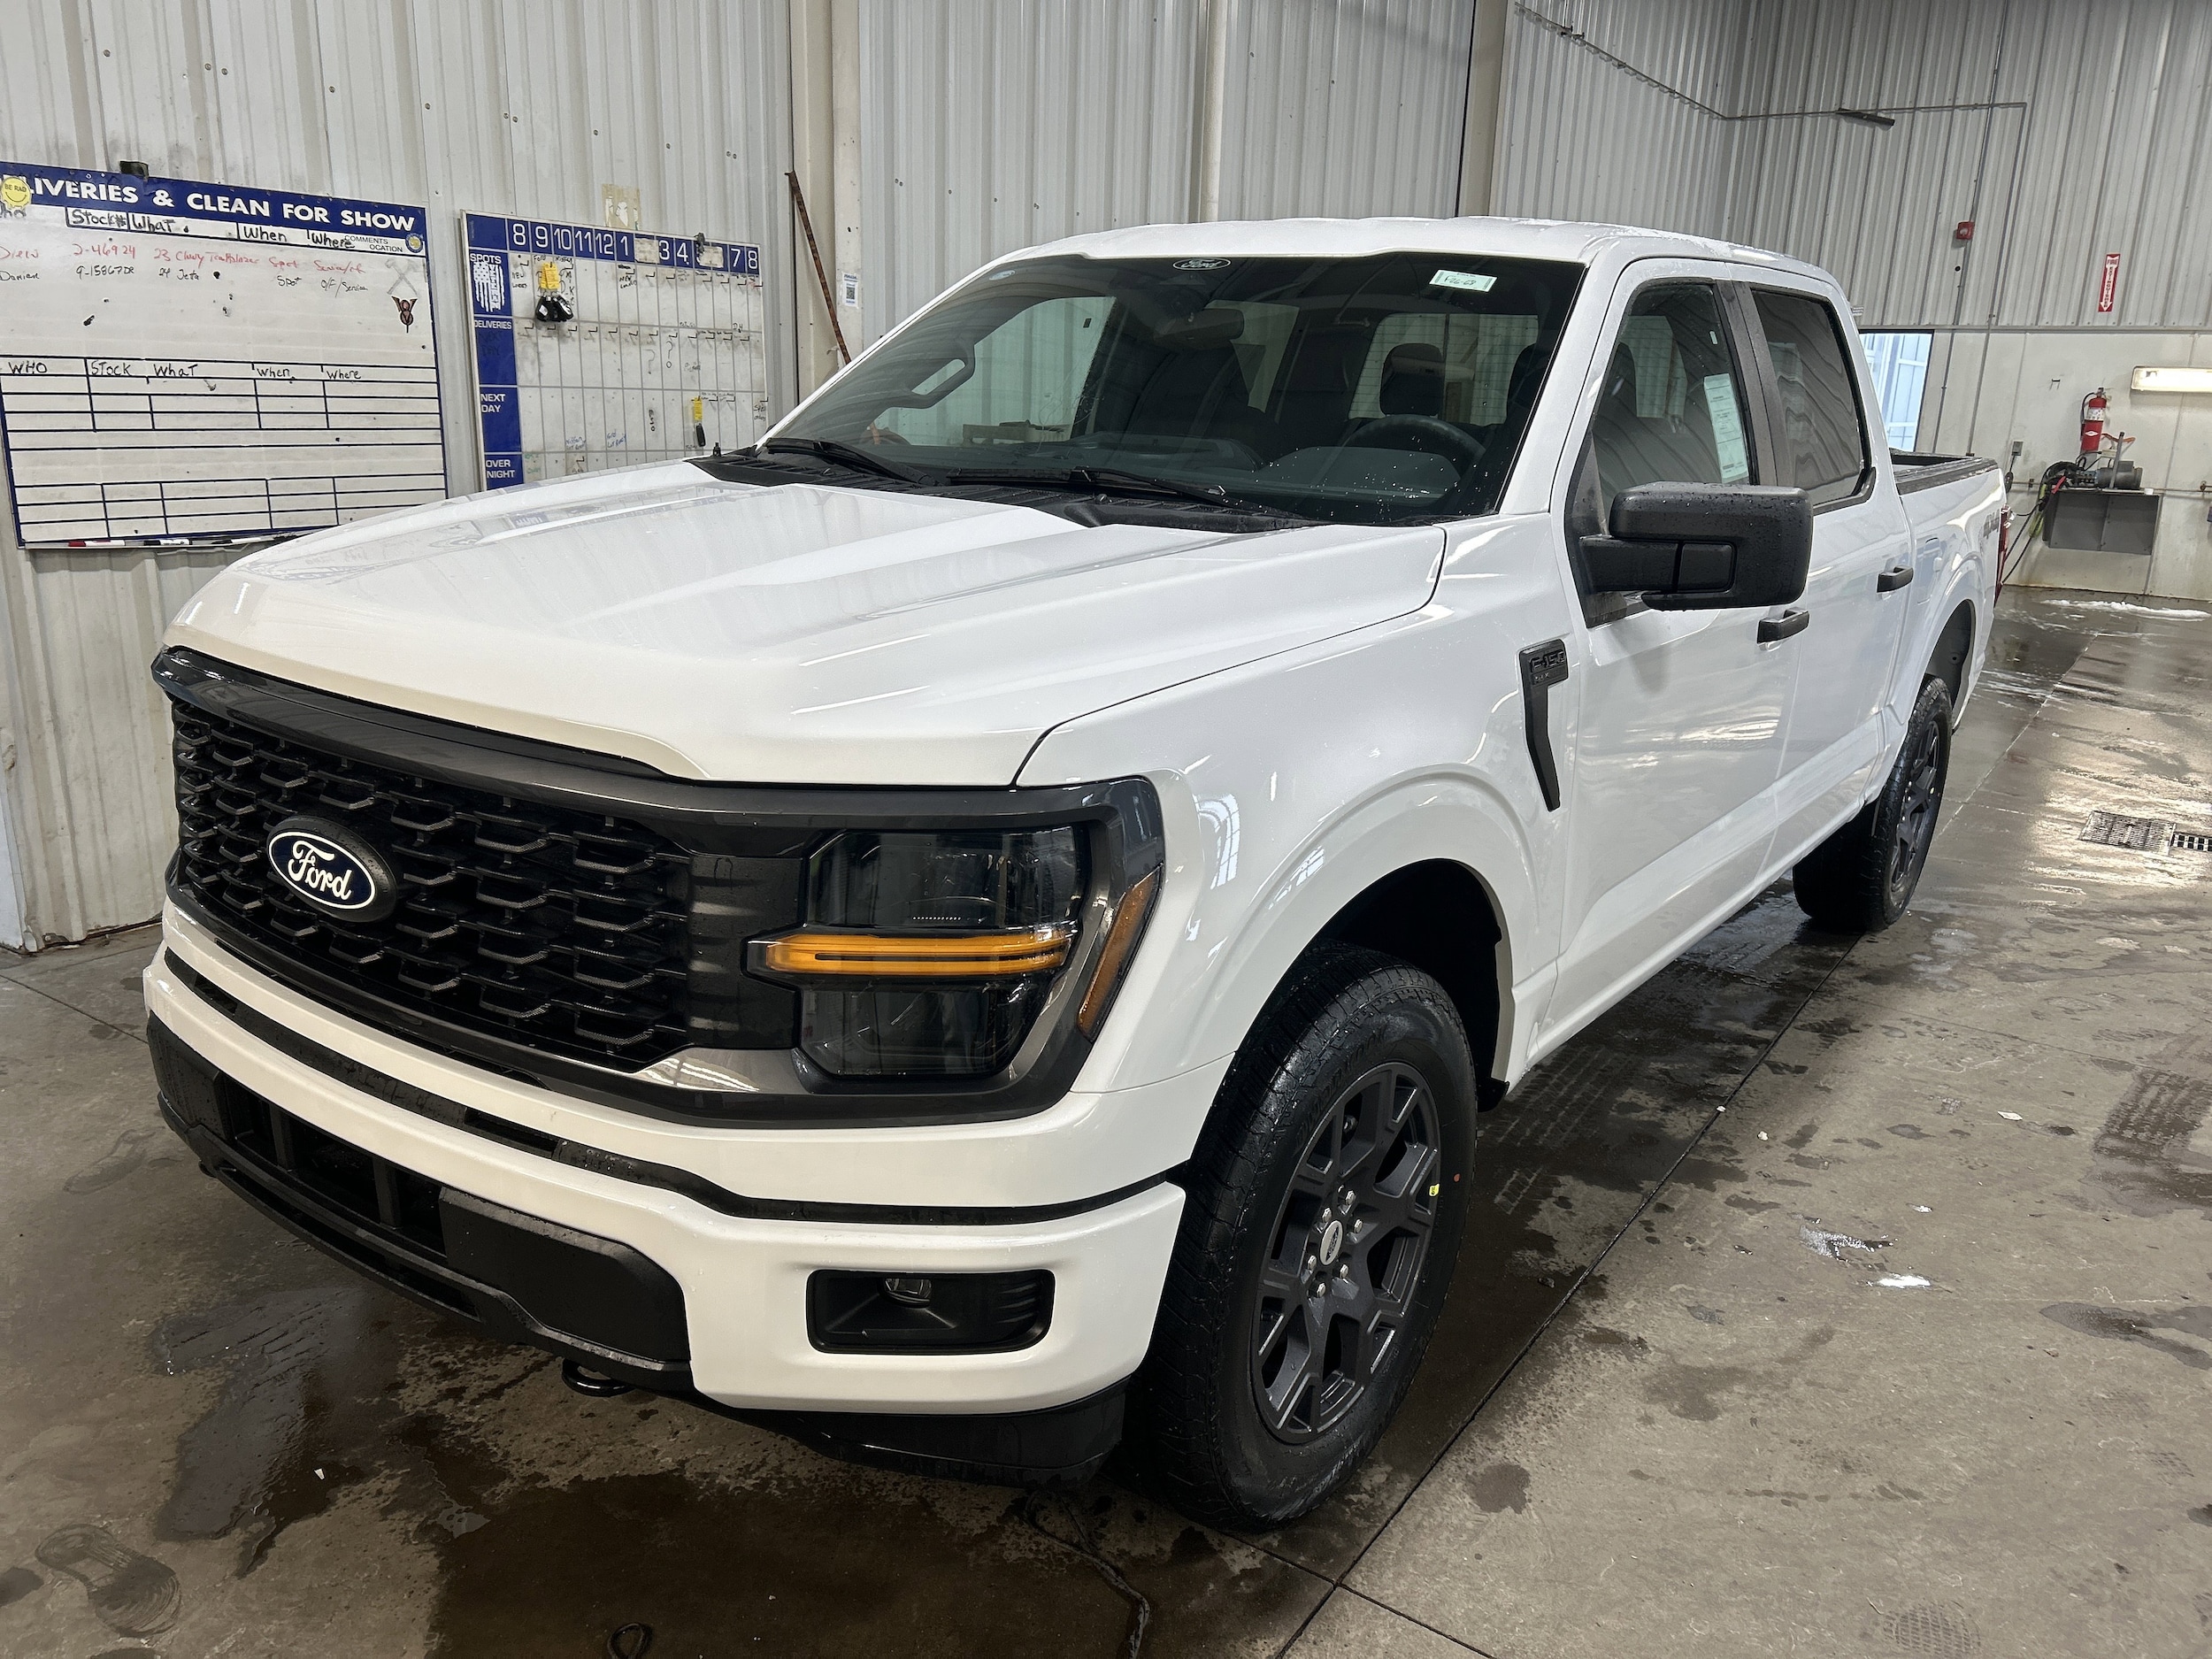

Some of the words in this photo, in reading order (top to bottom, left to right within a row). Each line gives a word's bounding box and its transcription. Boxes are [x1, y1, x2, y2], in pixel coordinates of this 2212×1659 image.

[14, 184, 27, 193] RAD
[0, 174, 139, 204] LIVERIES
[153, 190, 174, 207] &
[187, 193, 270, 217] CLEAN
[282, 203, 330, 224] FOR
[341, 210, 415, 231] SHOW
[243, 226, 288, 242] When
[311, 232, 355, 249] Where
[344, 234, 388, 245] COMMENTS
[512, 223, 526, 246] 8
[535, 226, 549, 248] 9
[554, 227, 572, 250] 10
[575, 230, 592, 252] 11
[595, 233, 614, 255] 12
[620, 235, 629, 257] 1
[658, 240, 670, 260] 3
[676, 242, 689, 262] 4
[730, 248, 741, 267] 7
[748, 250, 758, 269] 8
[470, 252, 502, 265] SPOTS
[473, 319, 512, 330] DELIVERIES
[8, 361, 48, 374] WHO
[257, 367, 290, 378] When
[326, 369, 362, 380] Where
[480, 393, 505, 403] NEXT
[481, 404, 501, 413] DAY
[486, 459, 511, 468] OVER
[487, 470, 515, 479] NIGHT
[288, 840, 353, 901] Ford
